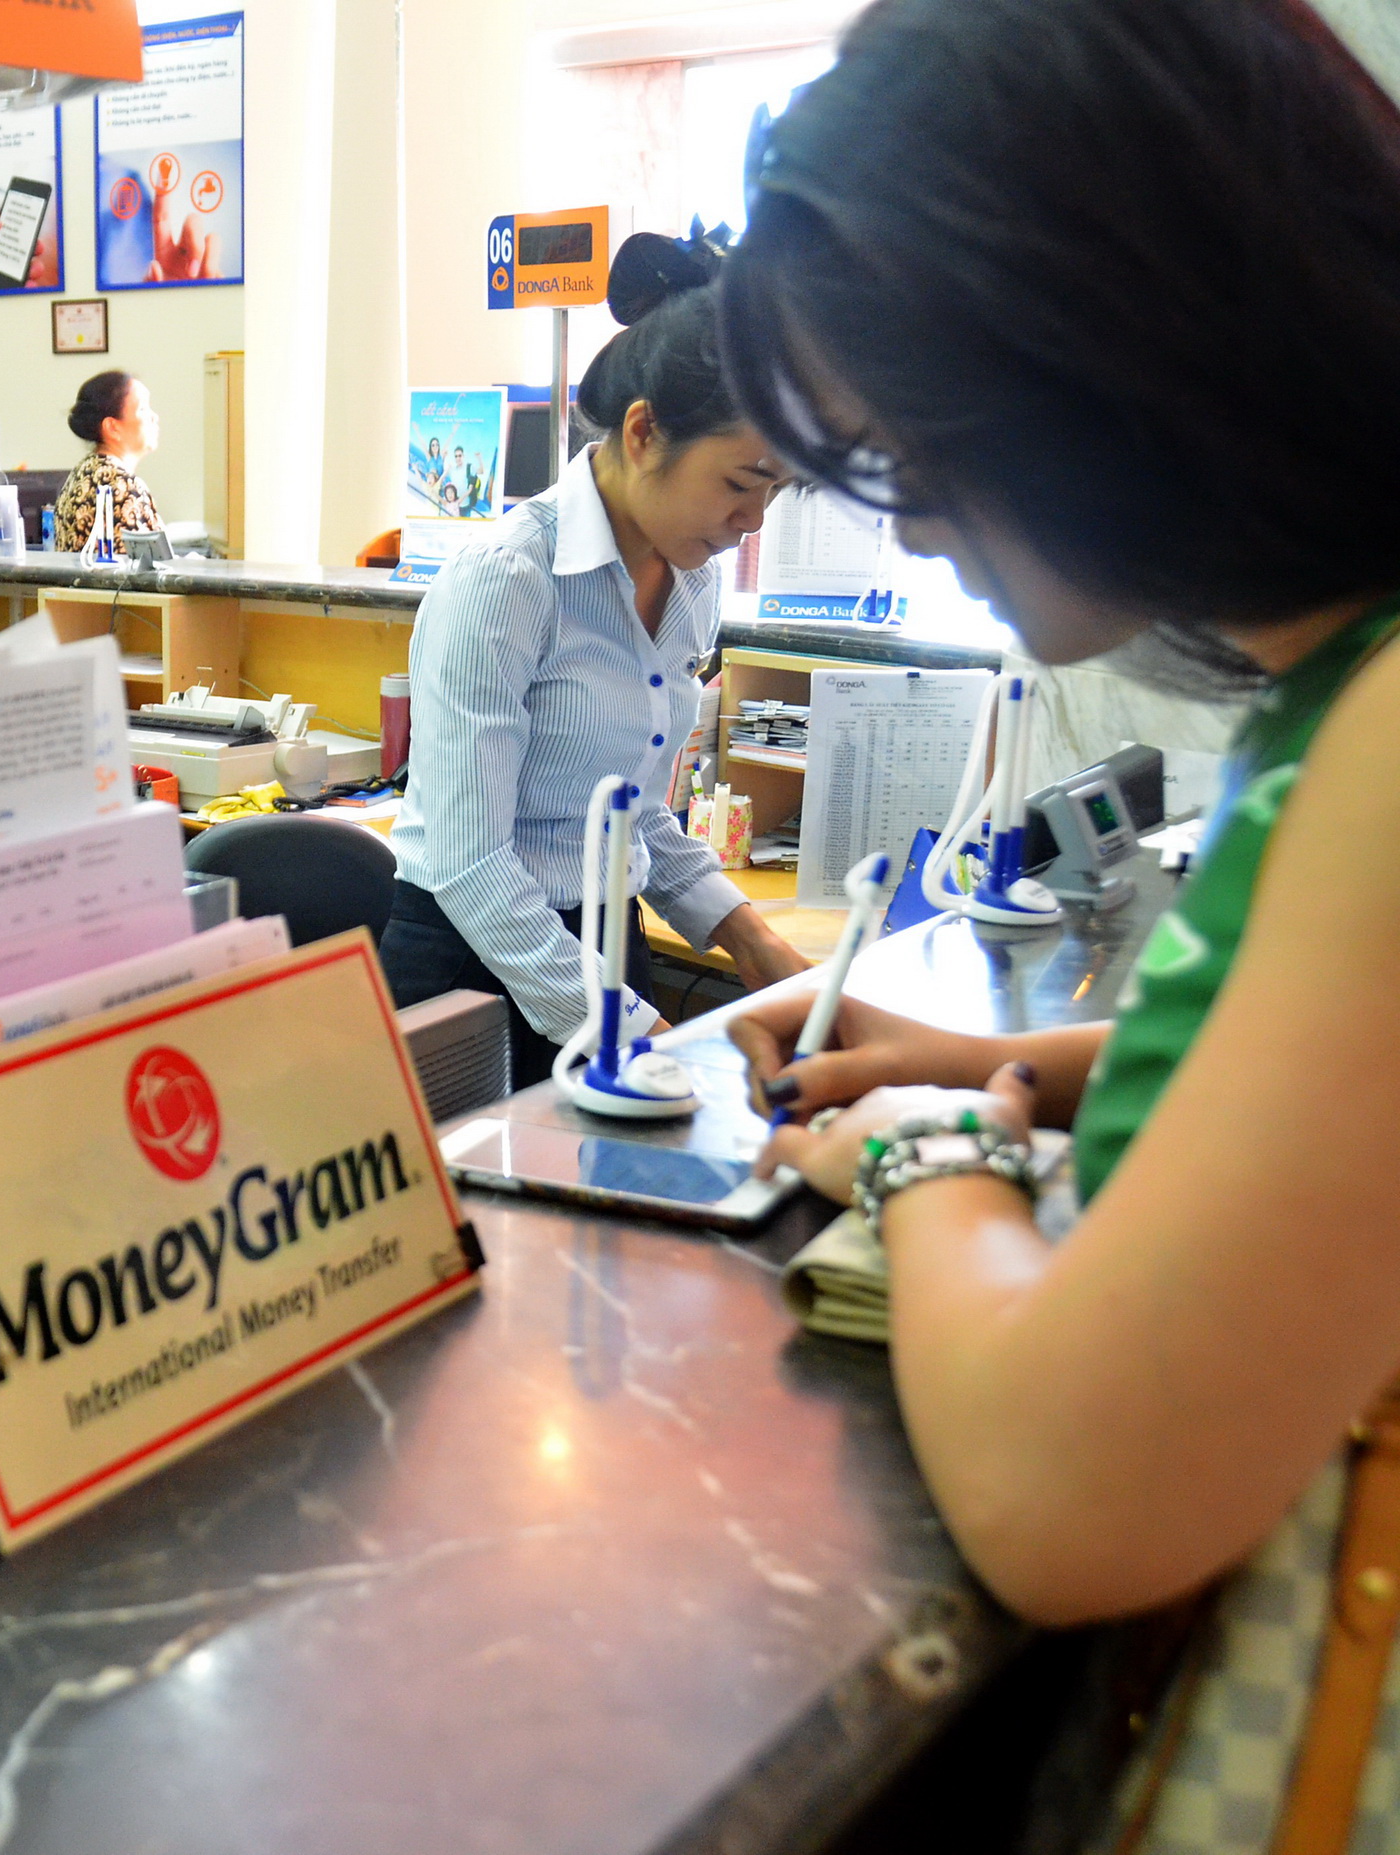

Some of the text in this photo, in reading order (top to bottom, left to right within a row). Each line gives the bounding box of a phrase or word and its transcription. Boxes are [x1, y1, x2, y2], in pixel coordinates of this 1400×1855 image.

[490, 228, 512, 264] 06
[518, 276, 593, 294] DONGA Bank
[780, 606, 829, 616] DONGA
[66, 1233, 402, 1430] International Money Transfer
